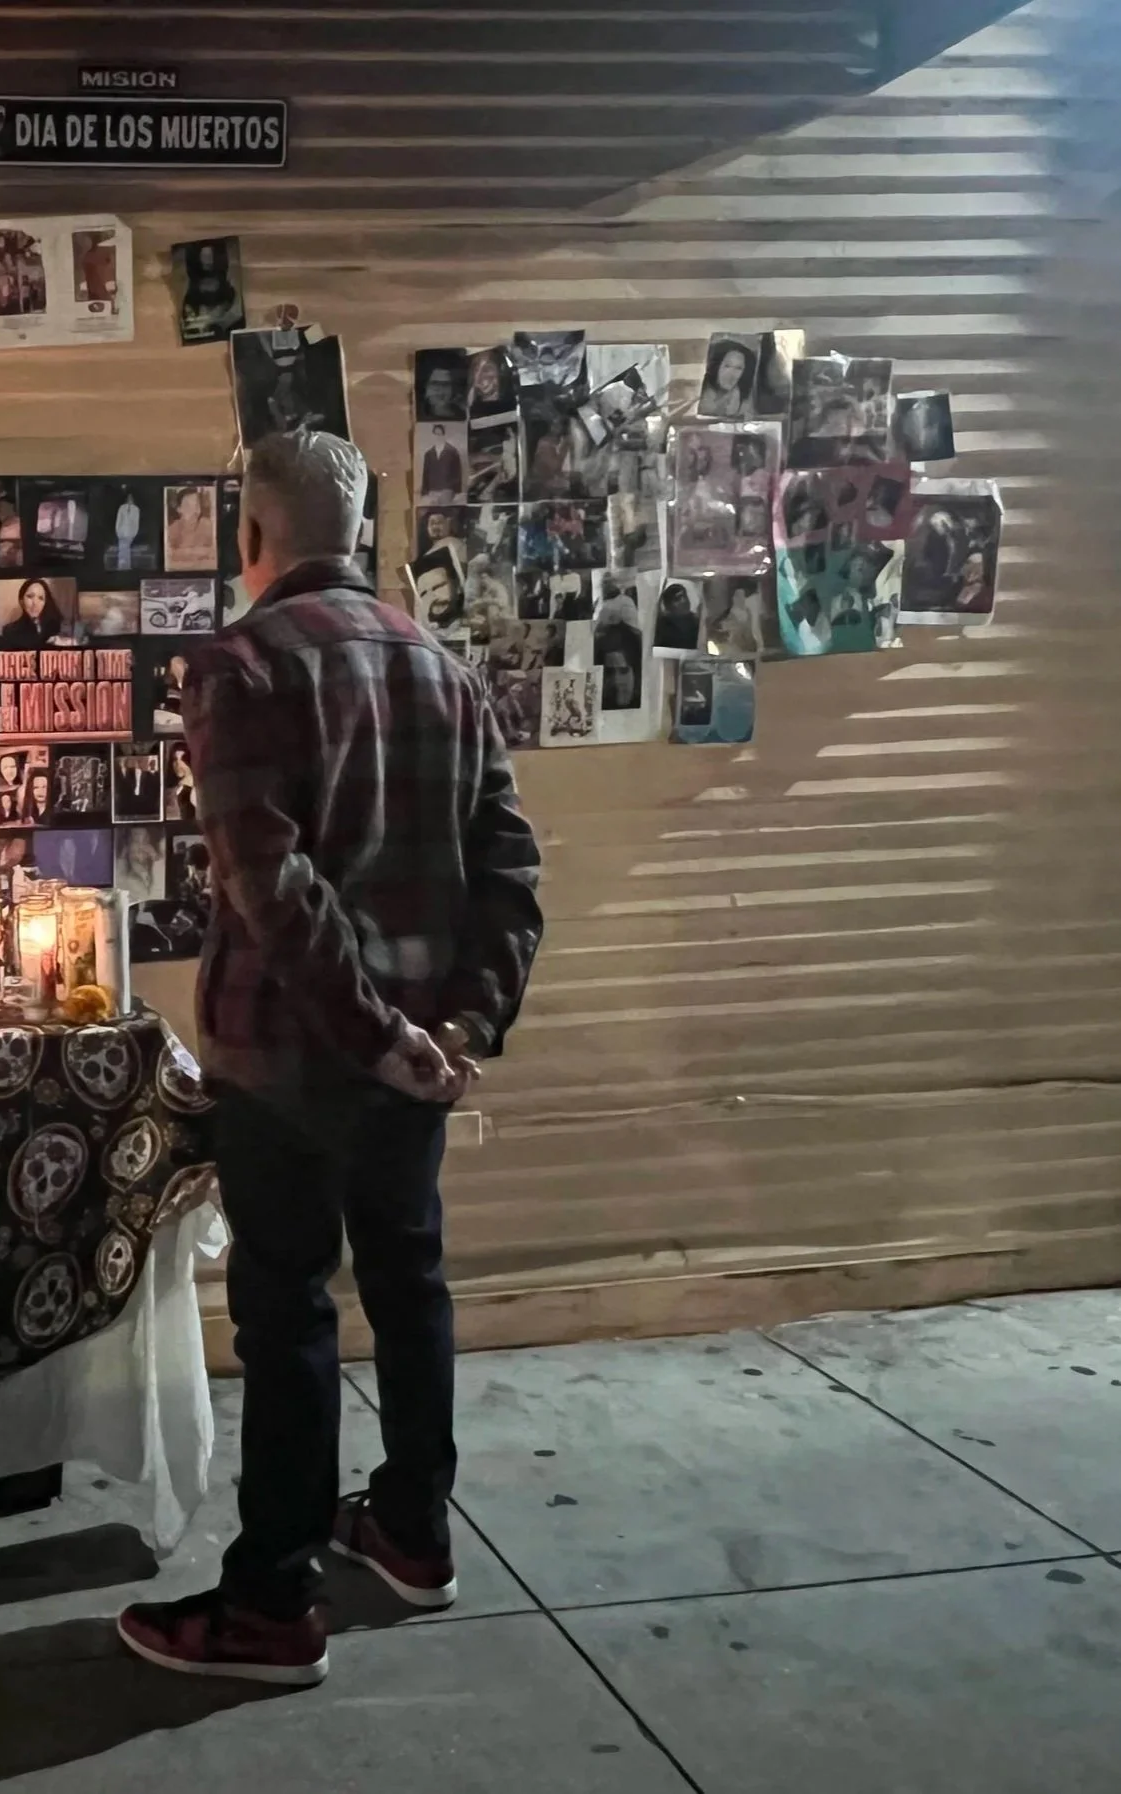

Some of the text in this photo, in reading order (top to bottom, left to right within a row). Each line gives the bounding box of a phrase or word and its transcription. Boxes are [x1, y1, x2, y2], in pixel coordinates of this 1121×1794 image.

[81, 71, 176, 88] MISION
[15, 112, 280, 150] DIA DE LOS MUERTOS
[19, 681, 132, 732] MISSION
